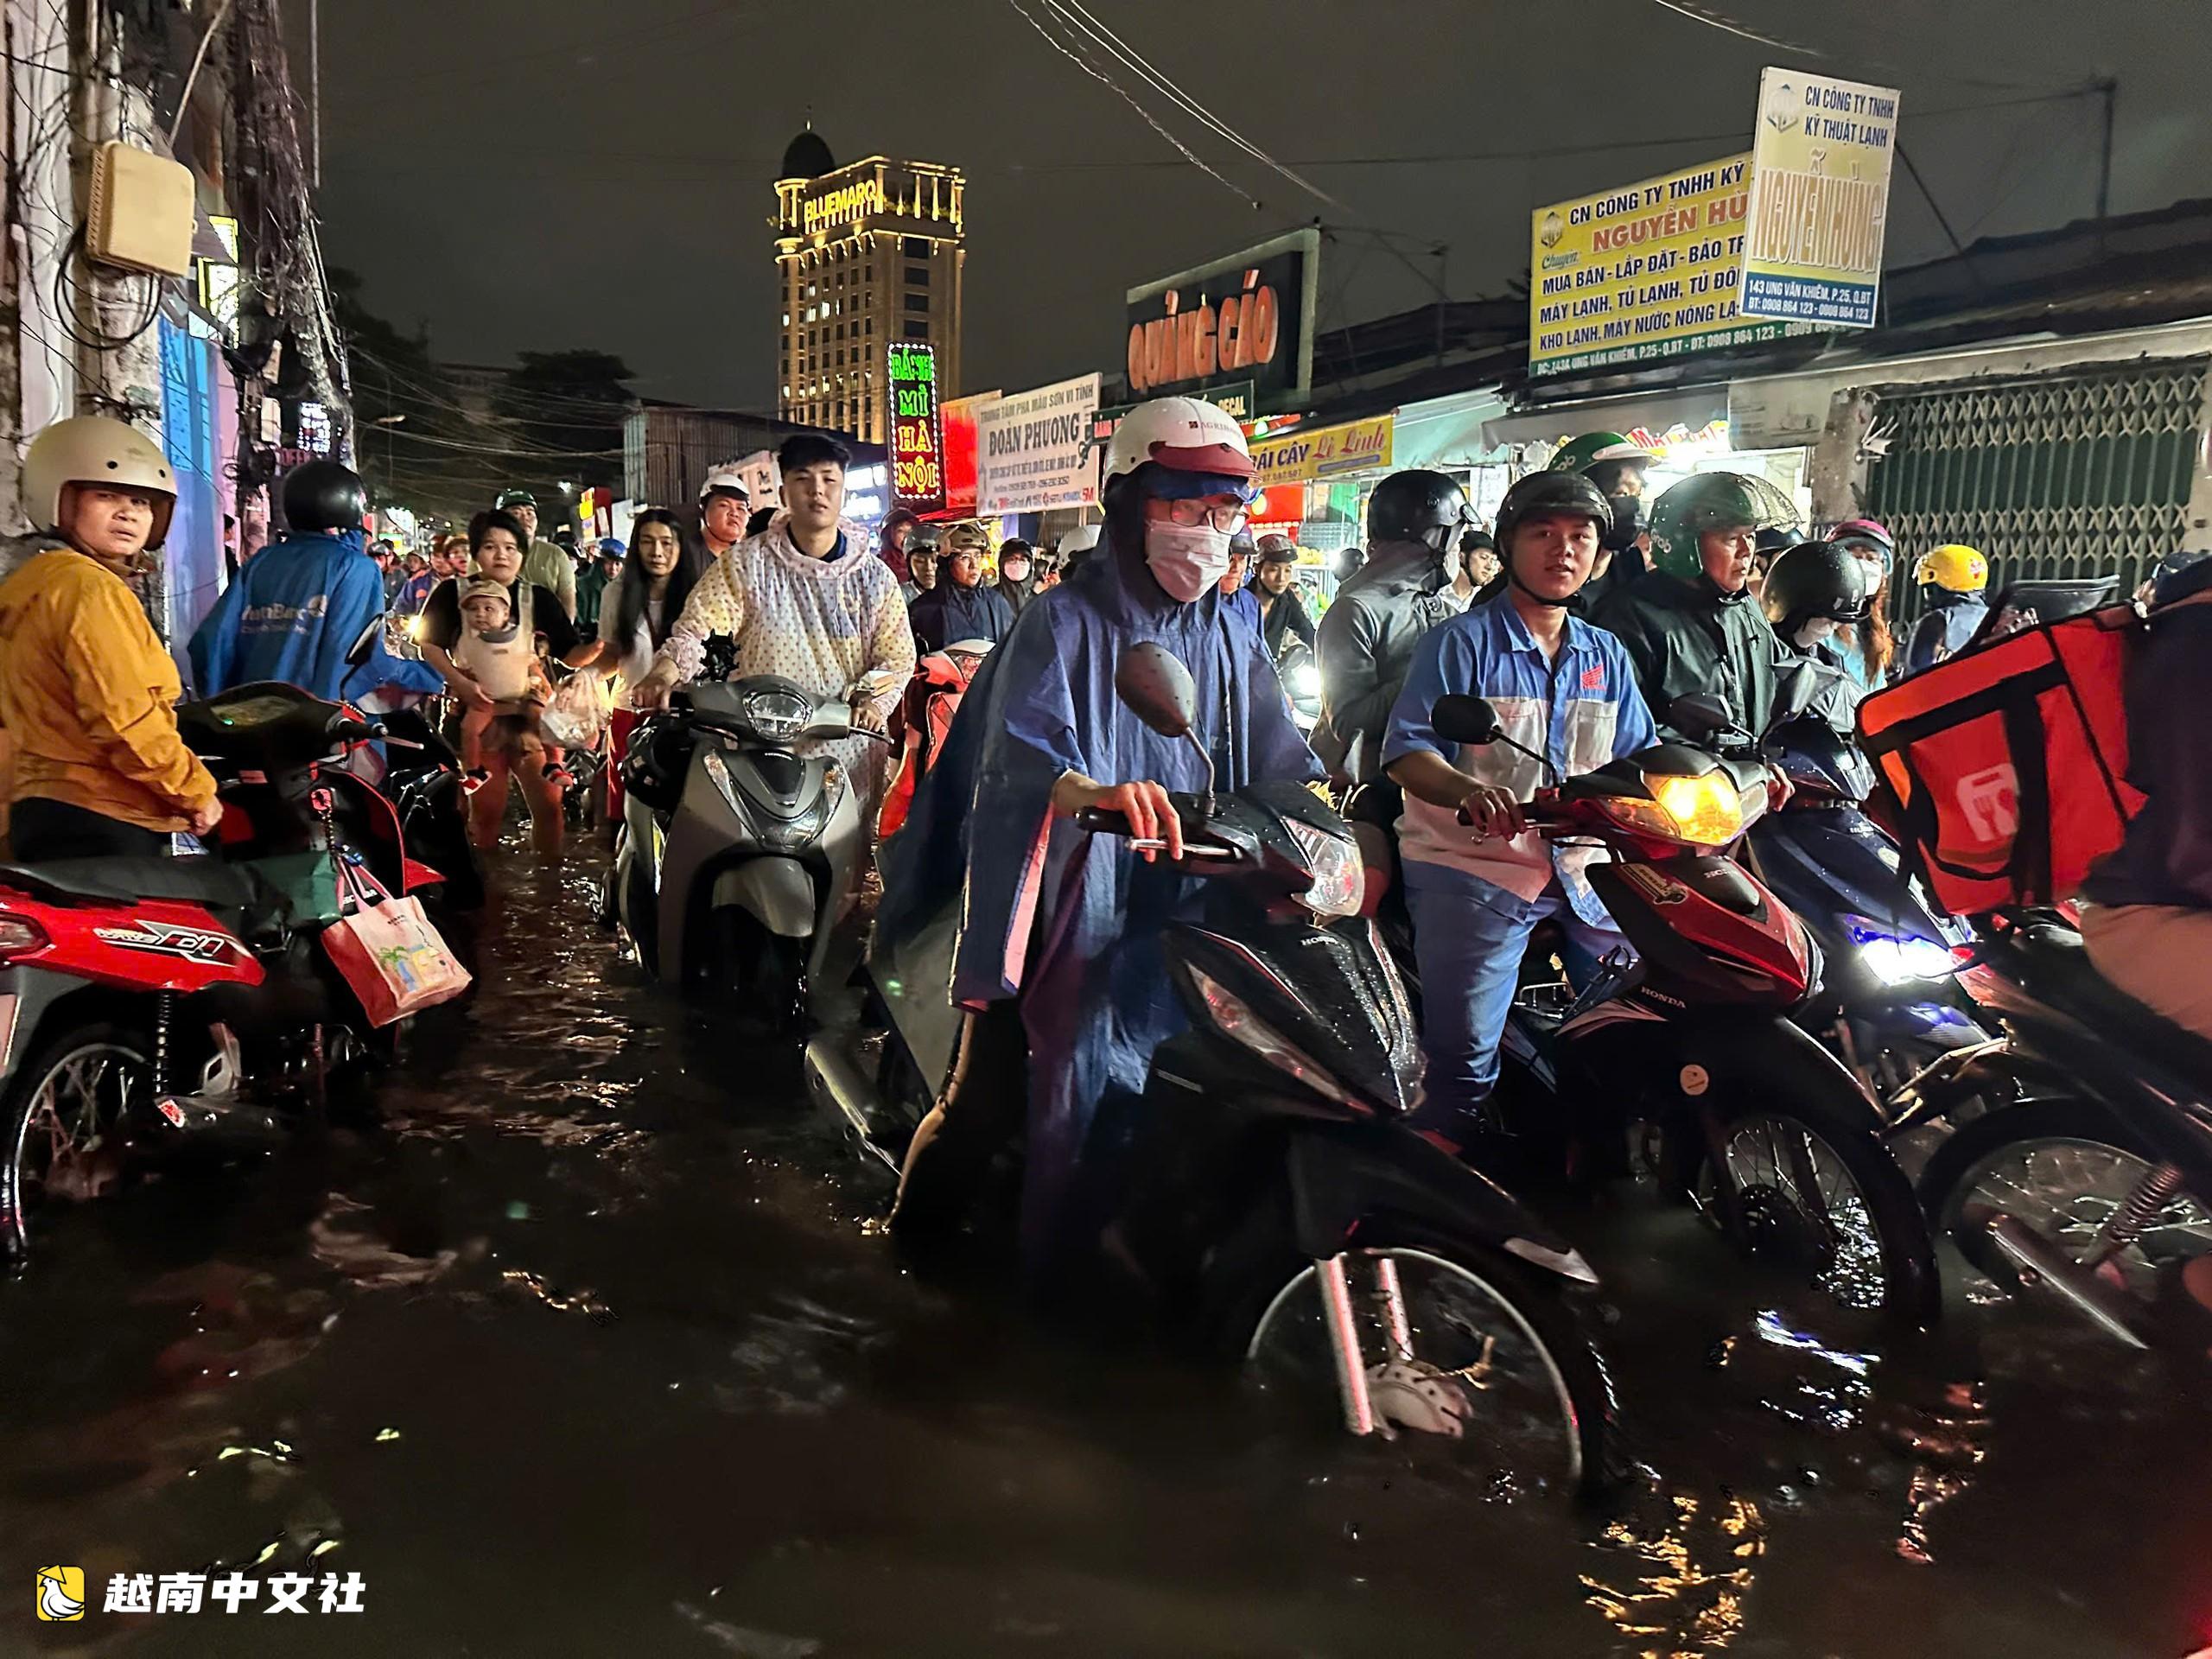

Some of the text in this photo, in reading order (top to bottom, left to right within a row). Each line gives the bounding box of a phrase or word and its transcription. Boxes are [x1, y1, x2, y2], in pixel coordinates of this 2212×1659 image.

[1805, 86, 1894, 119] CN CÔNG TY TNHH
[1805, 113, 1888, 149] KỸ THUẬT LẠNH
[804, 180, 877, 222] BLUEMARQ
[1570, 161, 1745, 226] CN CÔNG TY TNHH KỸ
[1592, 189, 1748, 252] NGUYỄN HÙ
[1542, 274, 1572, 295] MUA
[1576, 265, 1605, 288] BÁN
[1616, 253, 1643, 279] LẮP
[1648, 249, 1678, 274] ĐẶT
[1688, 237, 1722, 264] BẢO
[1541, 303, 1569, 324] MÁY
[1573, 296, 1612, 322] LẠNH,
[1618, 284, 1635, 308] TỦ
[1640, 280, 1684, 305] LẠNH,
[1689, 270, 1708, 295] TỦ
[1749, 279, 1764, 295] 143
[1765, 281, 1783, 296] UNG
[1784, 282, 1802, 297] VĂN
[1832, 289, 1852, 303] P.25,
[1853, 290, 1872, 305] Q.BT
[1218, 270, 1279, 372] CÁO
[1540, 332, 1563, 351] KHO
[1567, 327, 1602, 349] LẠNH,
[1604, 318, 1630, 340] MÁY
[1635, 309, 1670, 334] NƯỚC
[1675, 302, 1714, 327] NÓNG
[1799, 302, 1814, 315] 123
[1855, 307, 1869, 320] 123
[1755, 326, 1775, 341] 123
[899, 383, 929, 416] MÌ
[898, 419, 933, 453] HÀ
[1277, 441, 1311, 467] CÂY
[1340, 423, 1385, 454] Linh
[897, 454, 939, 493] NỘI
[1650, 528, 1672, 554] Grab
[1641, 986, 1687, 1009] HONDA
